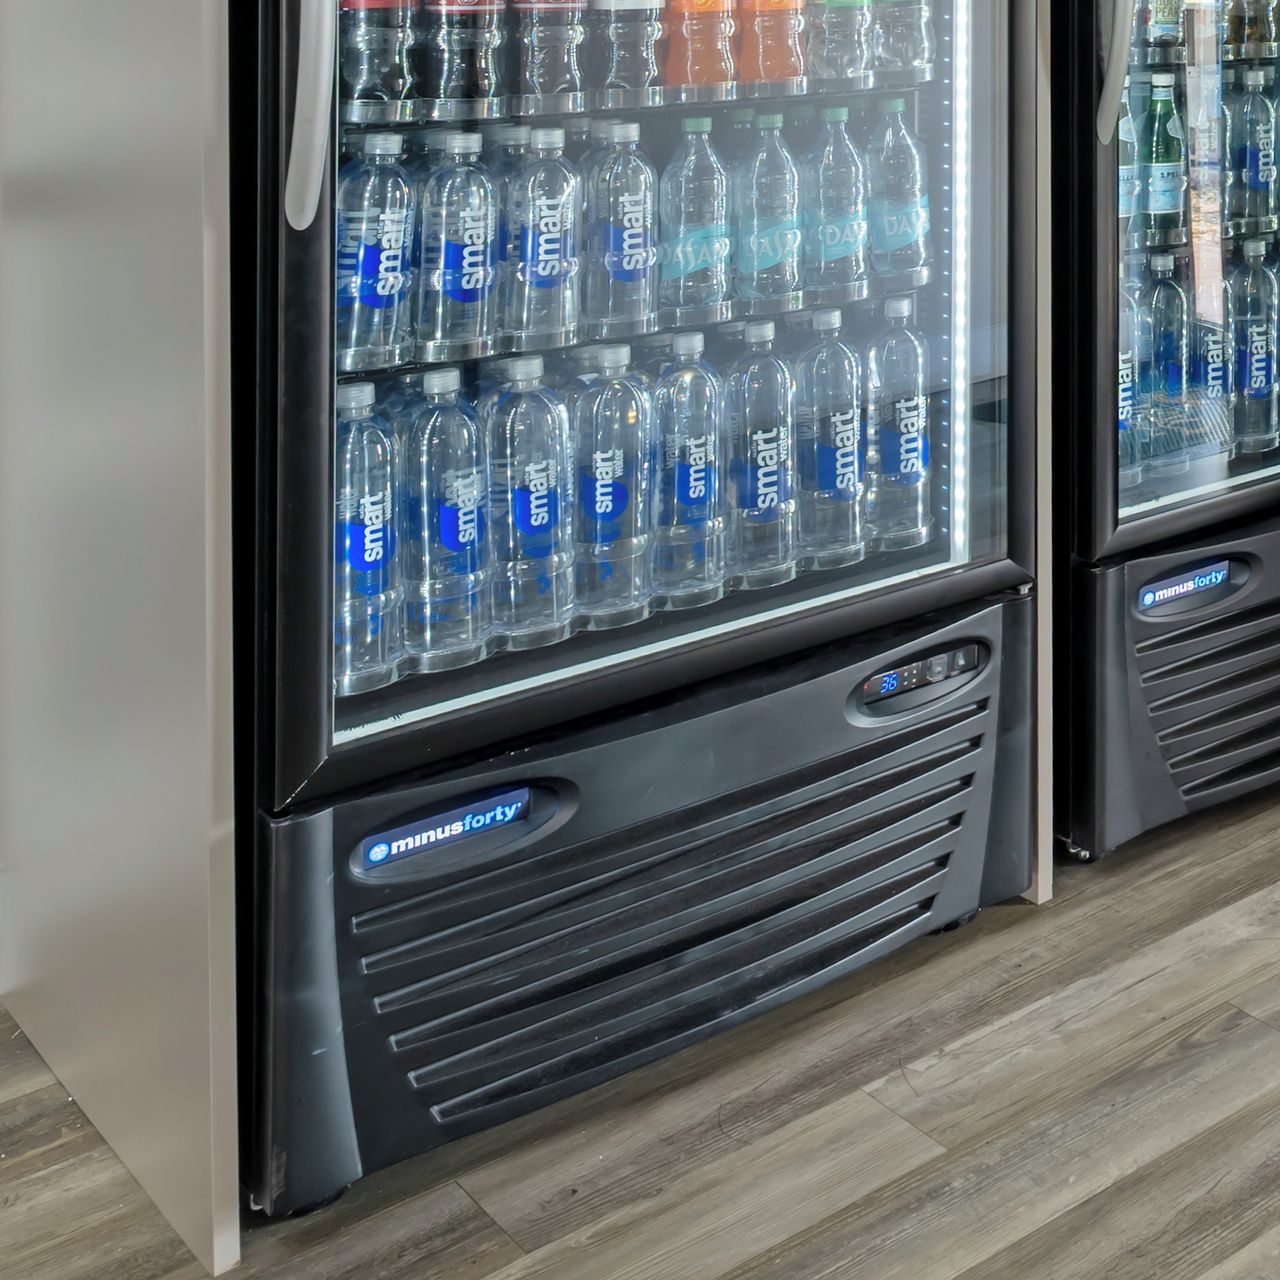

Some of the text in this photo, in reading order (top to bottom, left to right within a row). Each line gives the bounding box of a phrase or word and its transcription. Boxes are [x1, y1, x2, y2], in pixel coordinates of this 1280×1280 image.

[1256, 121, 1273, 183] smart
[377, 206, 402, 295] smart
[461, 206, 485, 290] smart
[536, 195, 562, 277] smart
[623, 191, 645, 271] smart
[1205, 332, 1224, 398] smart
[1249, 323, 1267, 388] smart
[686, 435, 705, 499] smart
[753, 426, 778, 509] smart
[779, 426, 787, 461] water
[832, 410, 854, 490] smart
[896, 397, 918, 474] smart
[458, 470, 478, 543] smart
[525, 459, 548, 527] smart
[593, 449, 614, 513] smart
[360, 490, 383, 562] smart
[1155, 570, 1223, 601] minusforty
[880, 674, 898, 694] 36
[391, 803, 517, 855] minusforty
